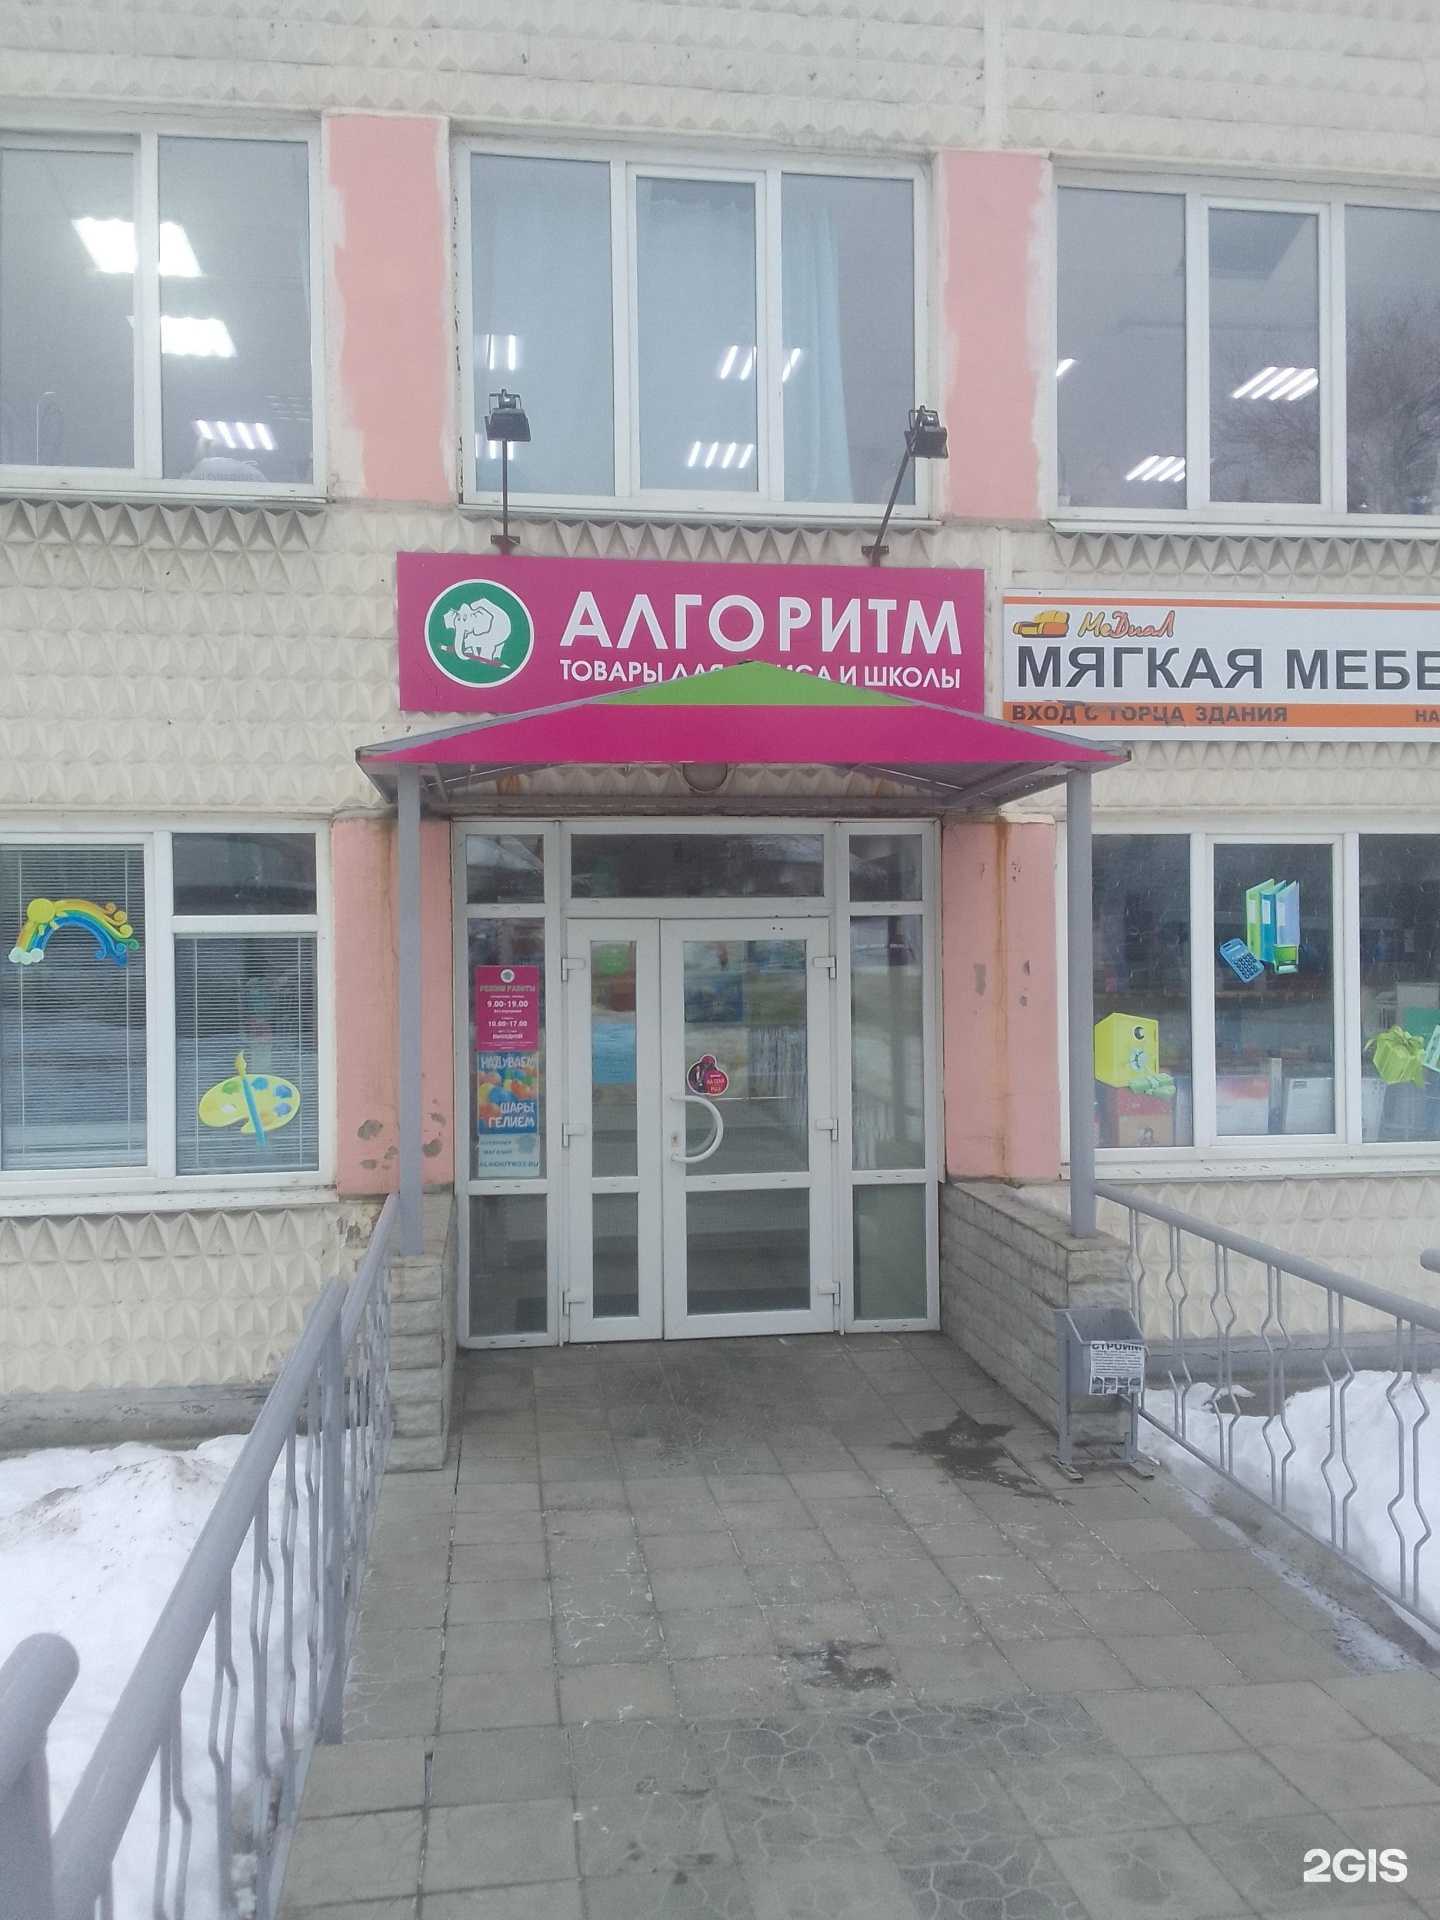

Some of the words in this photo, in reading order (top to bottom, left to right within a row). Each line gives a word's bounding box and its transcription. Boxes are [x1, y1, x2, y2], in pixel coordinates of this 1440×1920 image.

[559, 591, 962, 655] АЛГОРИТМ
[559, 659, 664, 683] ТОВАРЫ
[839, 665, 857, 686] И
[864, 666, 961, 689] ШКОЛЫ
[1016, 645, 1263, 688] МЯГКАЯ
[1286, 649, 1440, 690] МЕБЕ
[1011, 703, 1077, 725] ВХОД
[1107, 705, 1185, 725] ТОРЦА
[1195, 705, 1288, 725] ЗДАНИЯ
[500, 1101, 536, 1114] ШАРЫ
[487, 1115, 536, 1129] ГЕЛИЕМ
